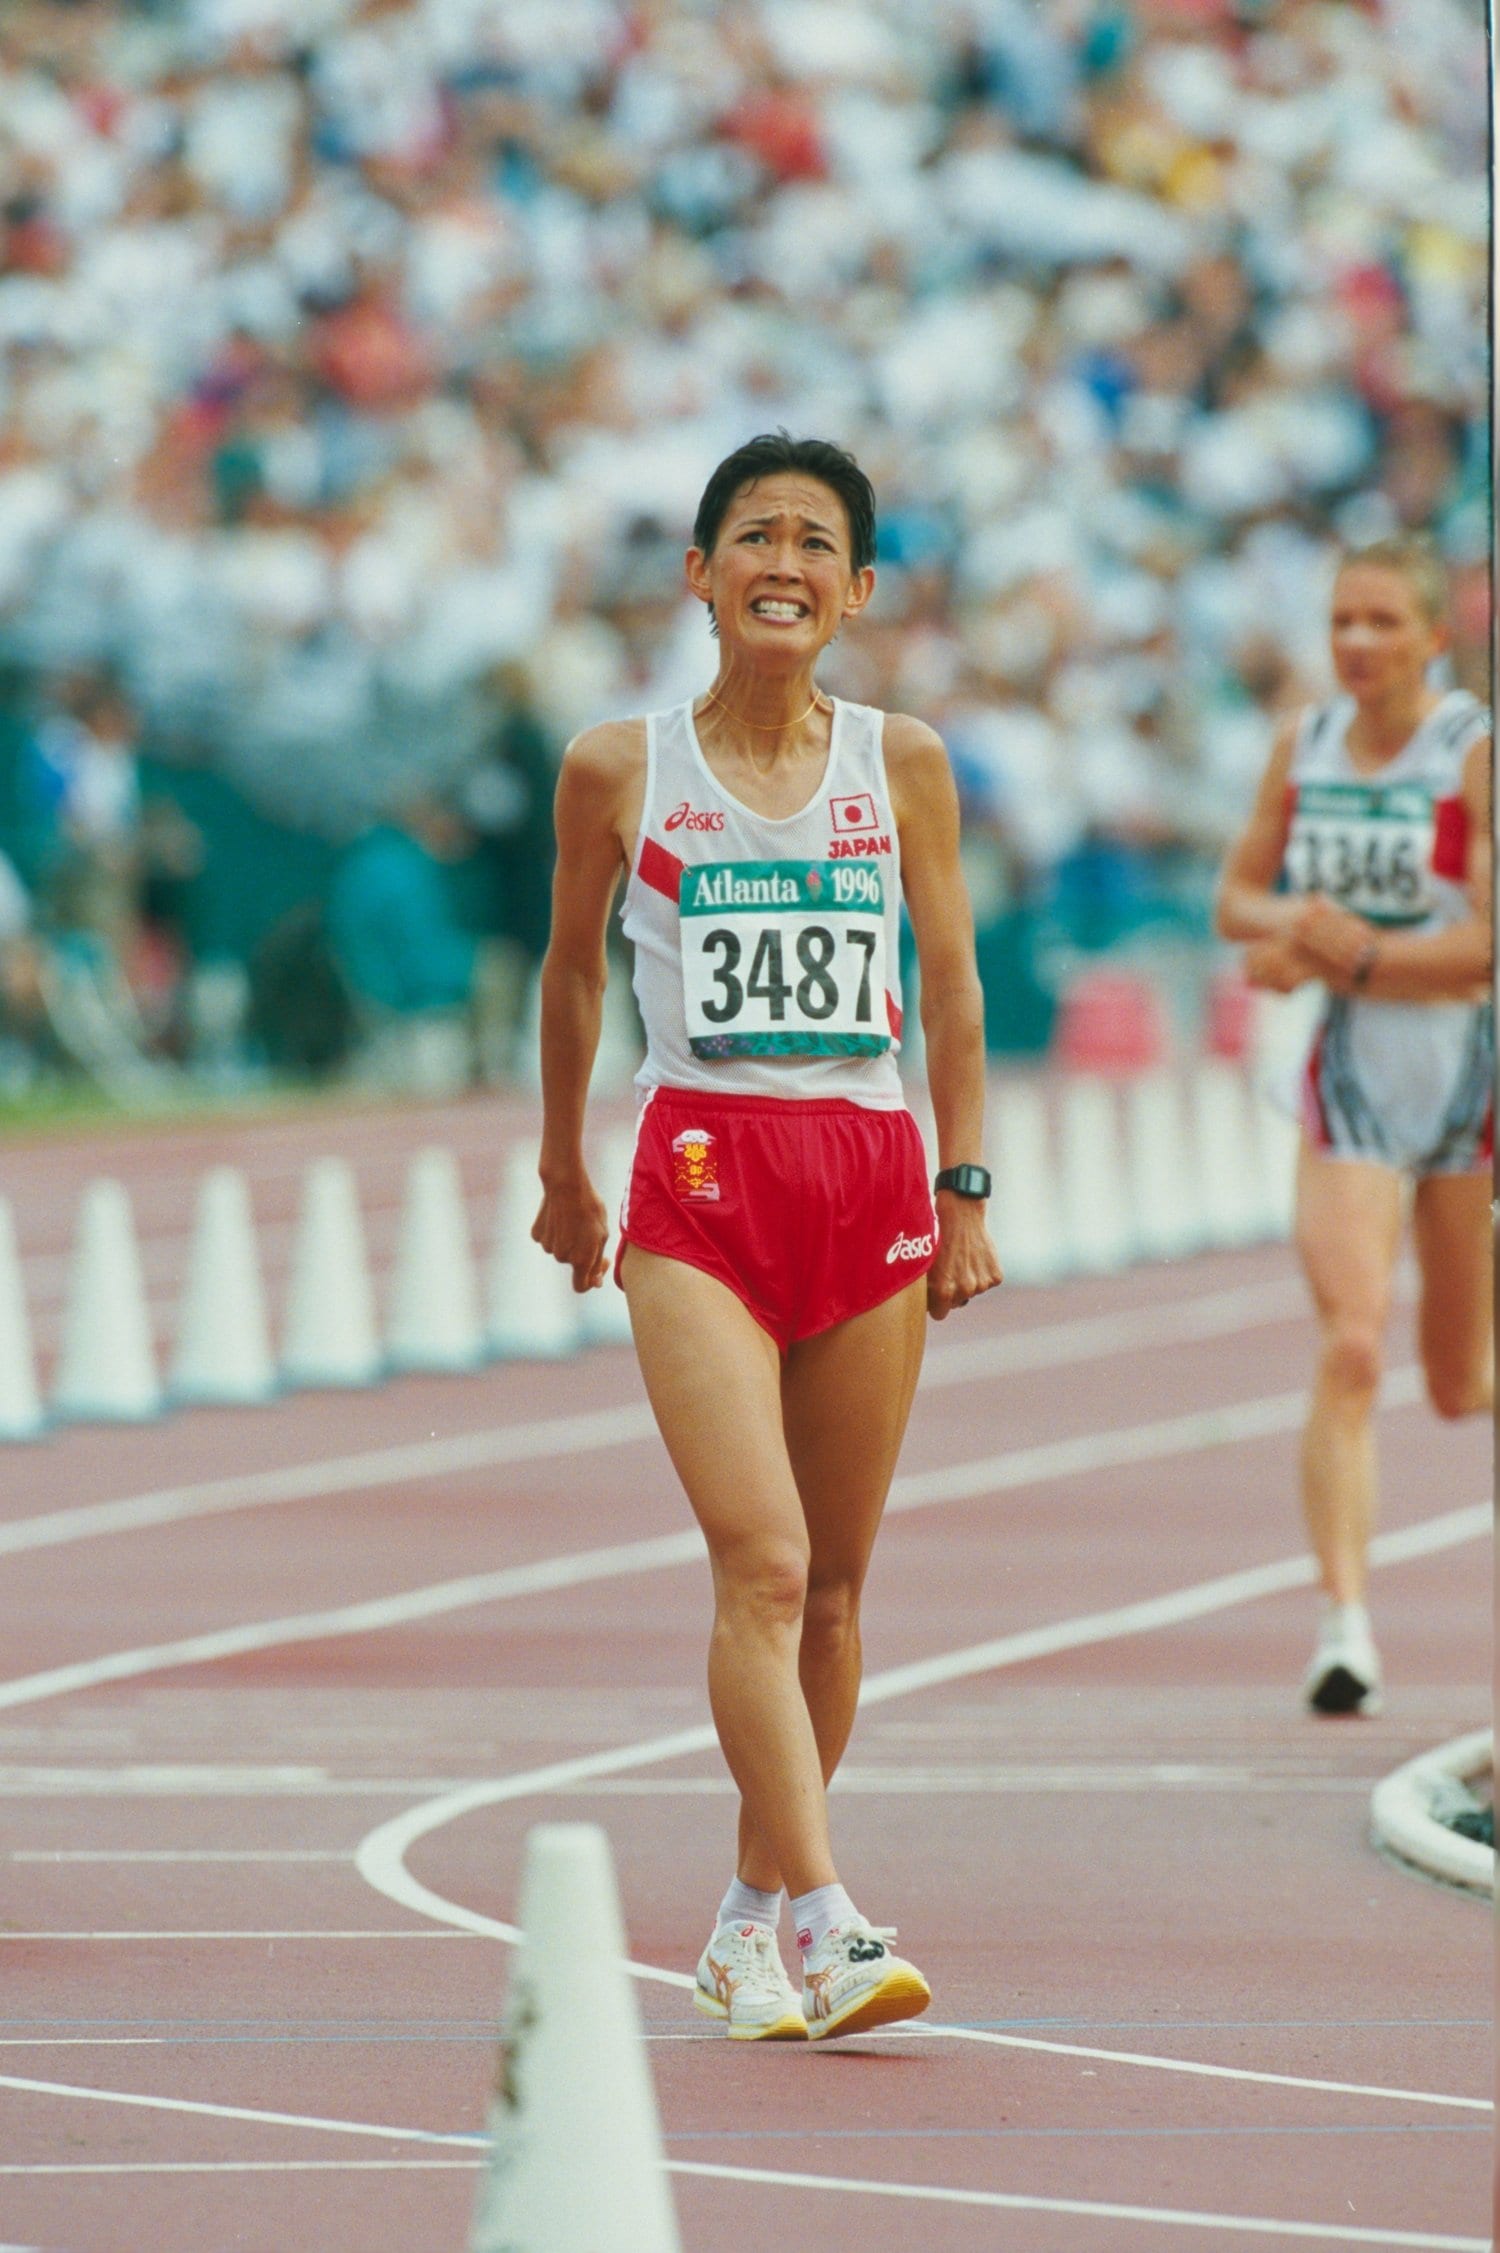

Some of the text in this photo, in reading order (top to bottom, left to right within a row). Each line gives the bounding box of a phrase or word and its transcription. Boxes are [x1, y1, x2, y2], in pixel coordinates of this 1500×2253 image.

[828, 836, 891, 859] JAPAN
[693, 868, 880, 907] Atlanta 1996
[701, 926, 877, 1023] 3487
